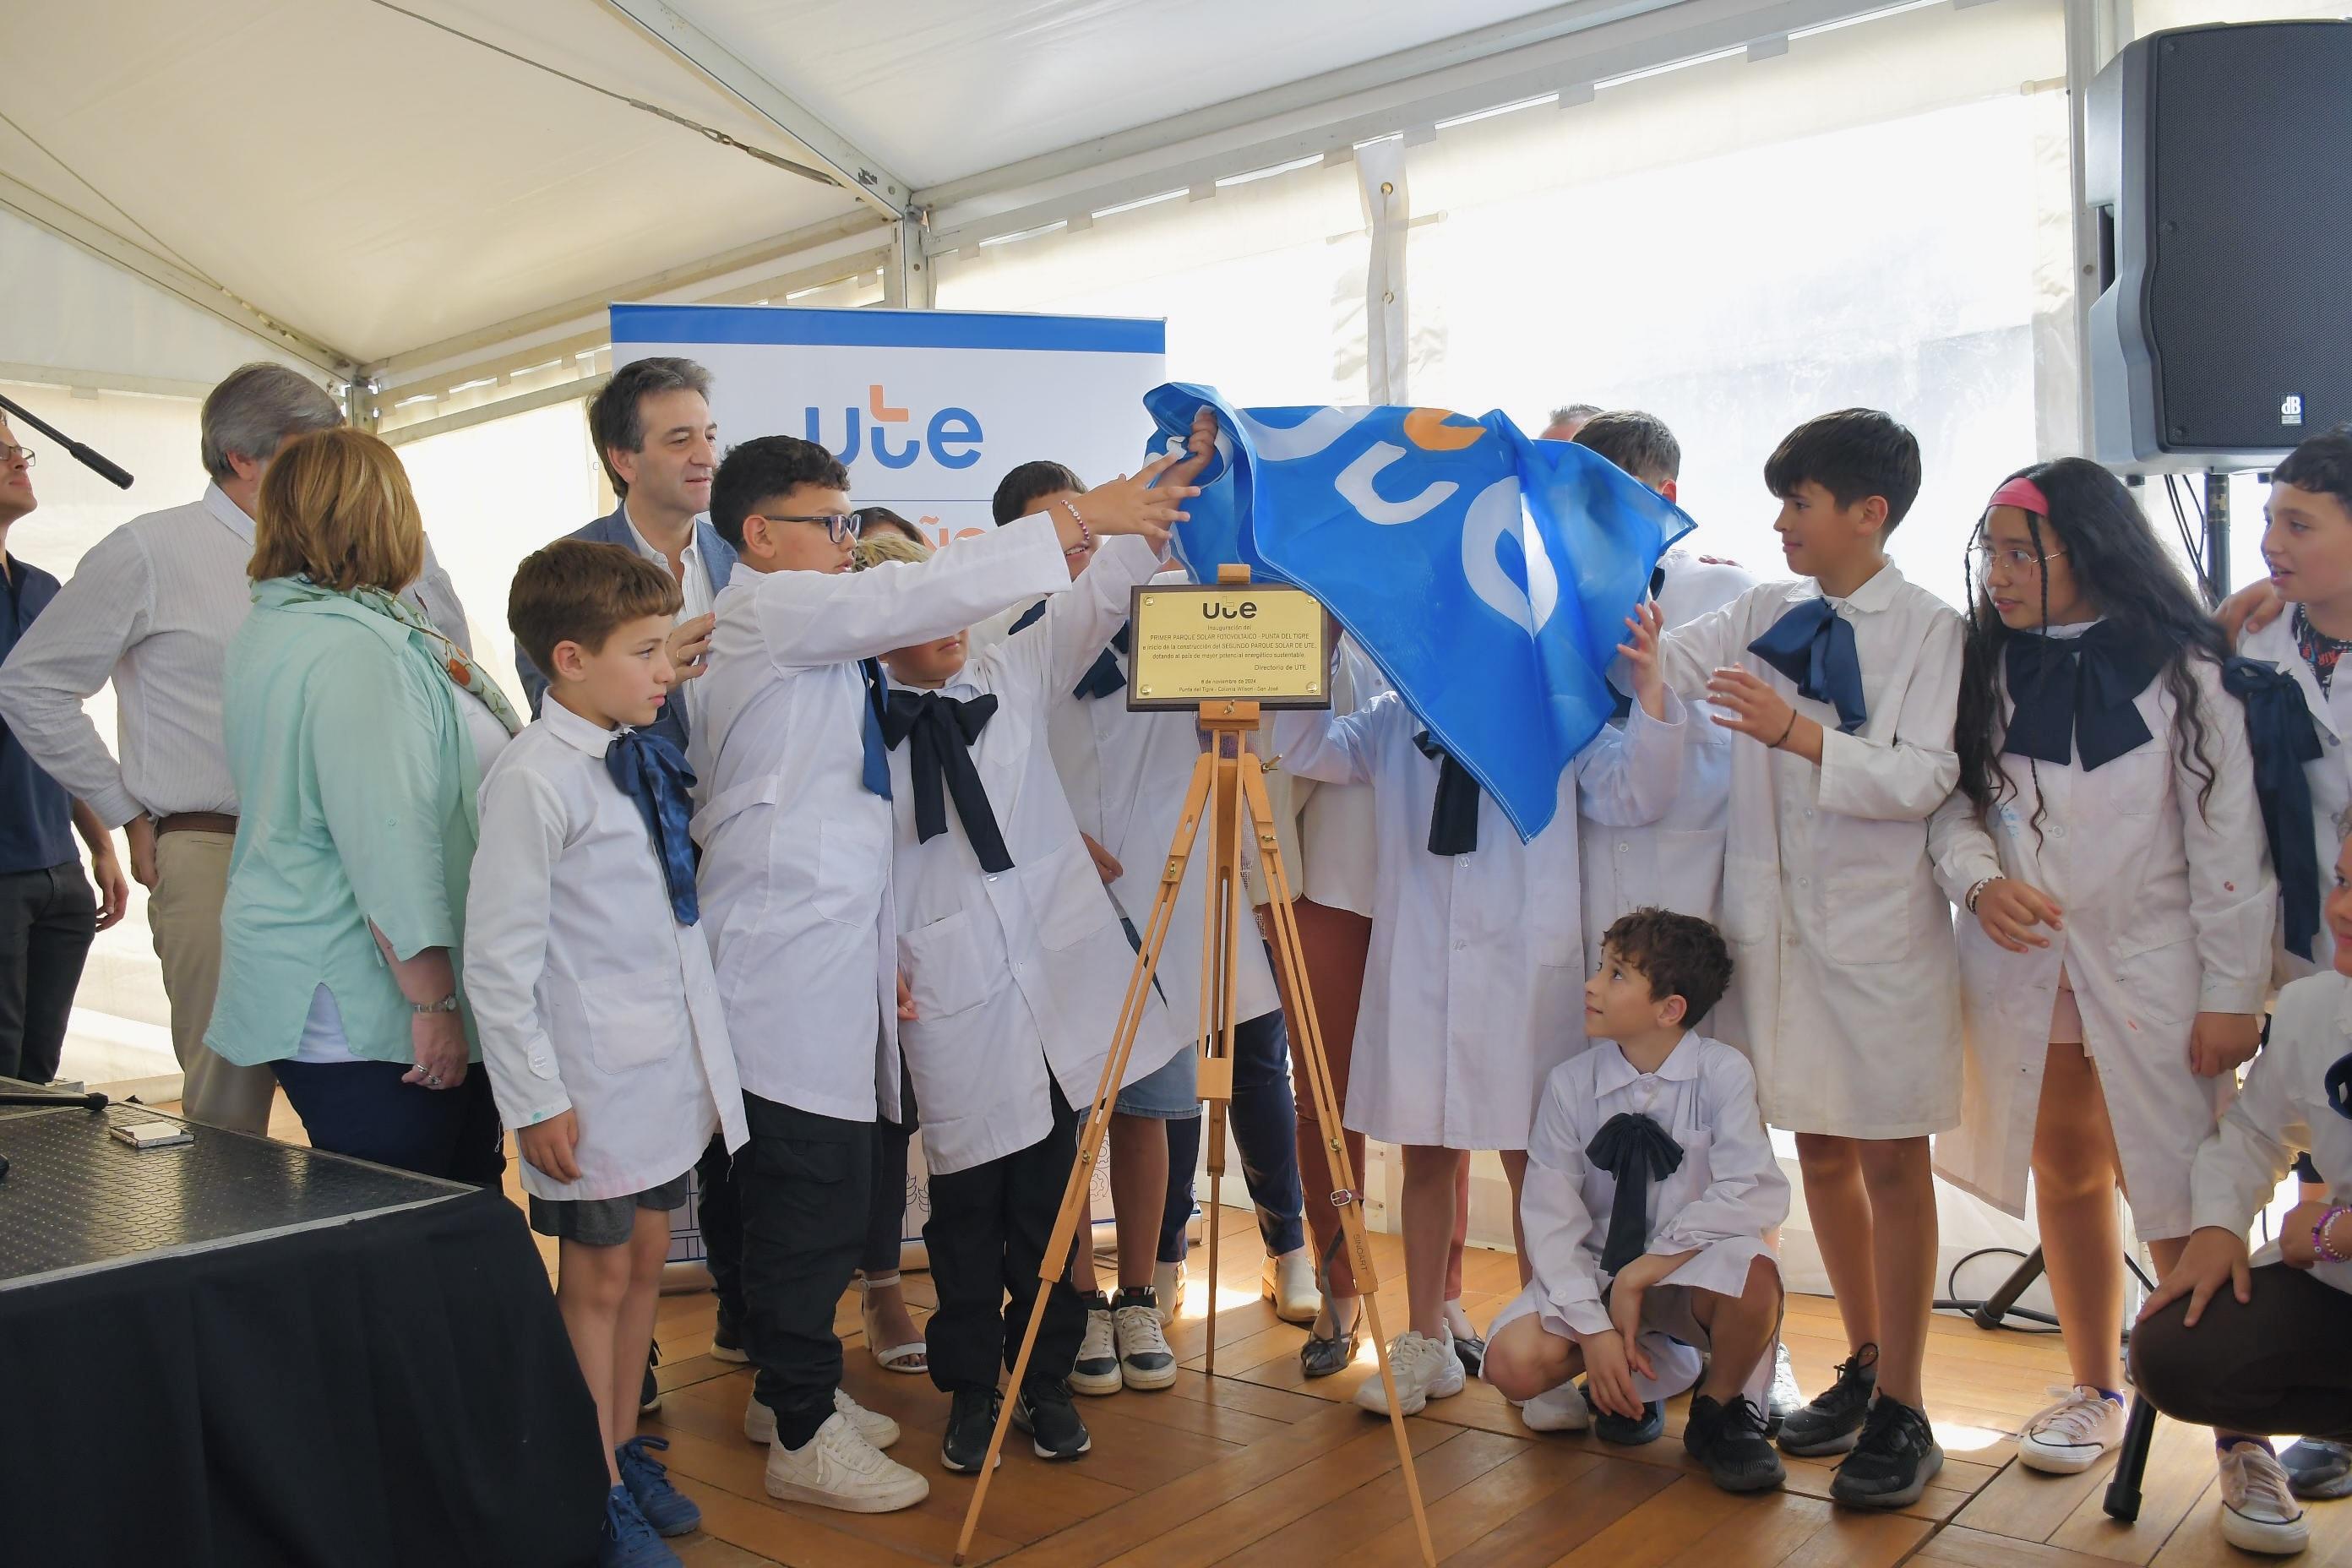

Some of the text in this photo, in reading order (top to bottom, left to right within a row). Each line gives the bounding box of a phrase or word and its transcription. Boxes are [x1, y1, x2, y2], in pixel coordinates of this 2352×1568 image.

[2281, 396, 2301, 415] dB
[805, 384, 983, 470] ute
[1202, 595, 1257, 619] ute
[1353, 1233, 1368, 1271] SINOART
